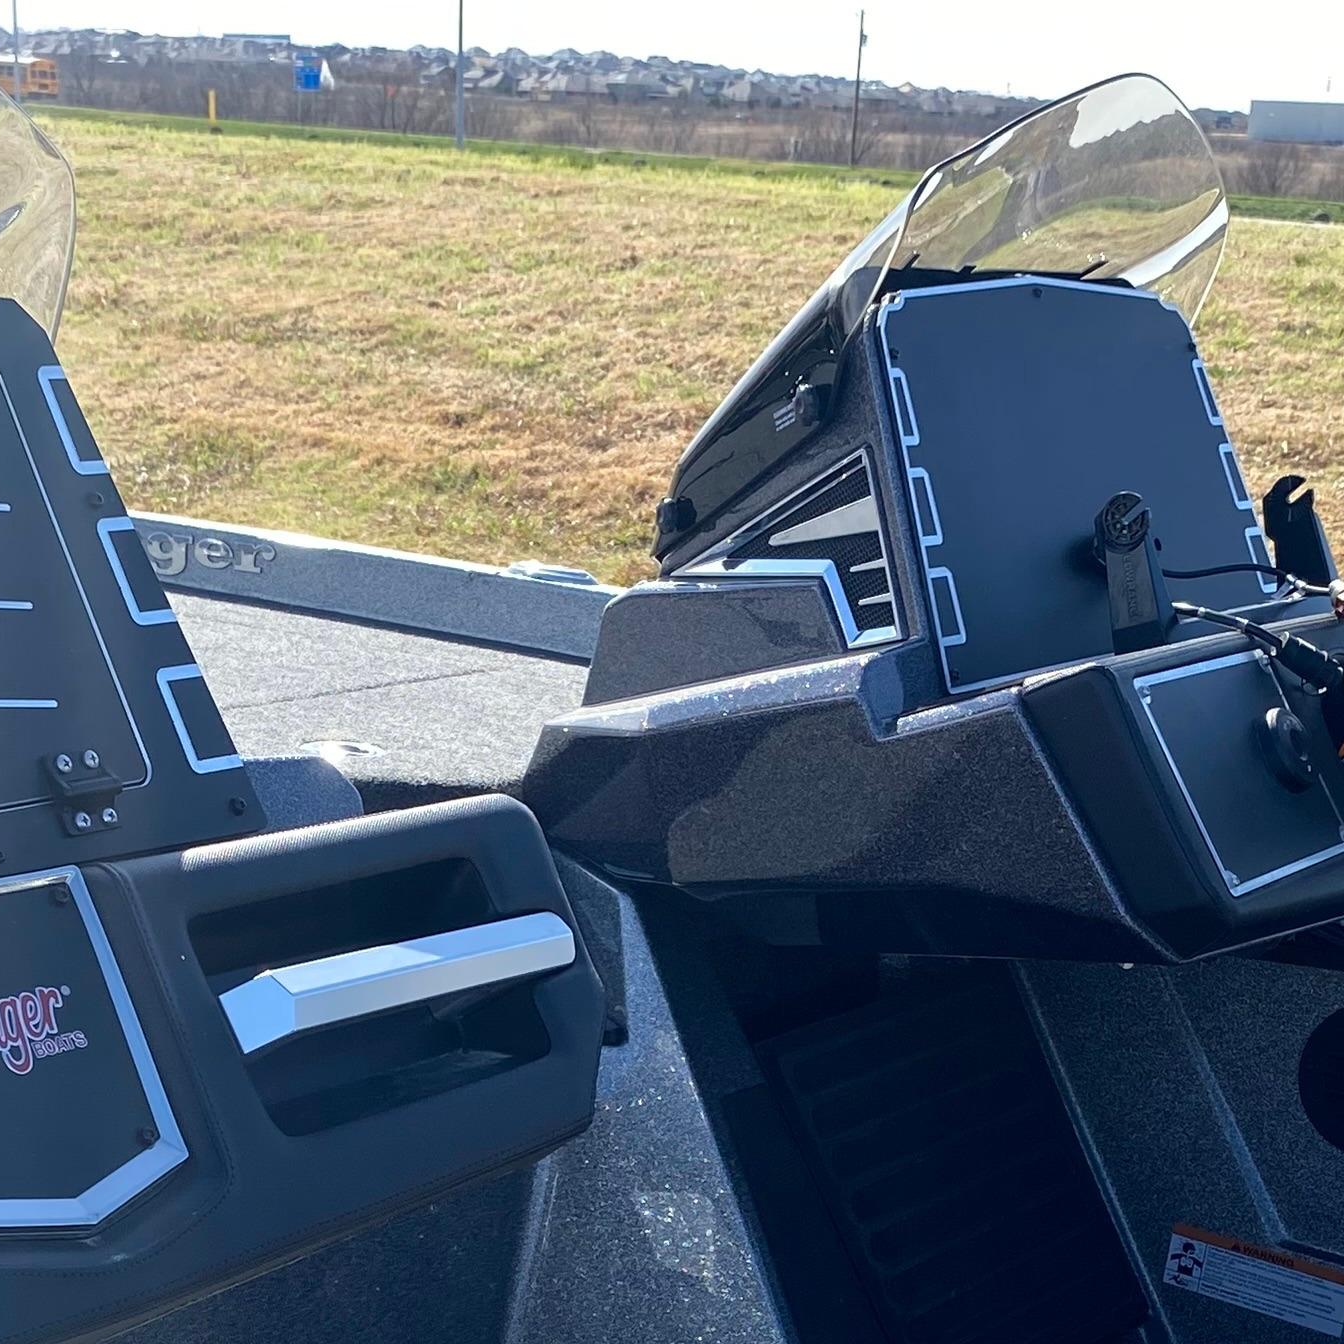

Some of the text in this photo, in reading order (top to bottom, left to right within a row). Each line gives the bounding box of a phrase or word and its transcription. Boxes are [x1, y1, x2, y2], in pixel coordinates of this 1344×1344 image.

[146, 531, 277, 577] ger
[31, 1030, 88, 1059] BOATS
[1243, 1243, 1295, 1267] WARNING
